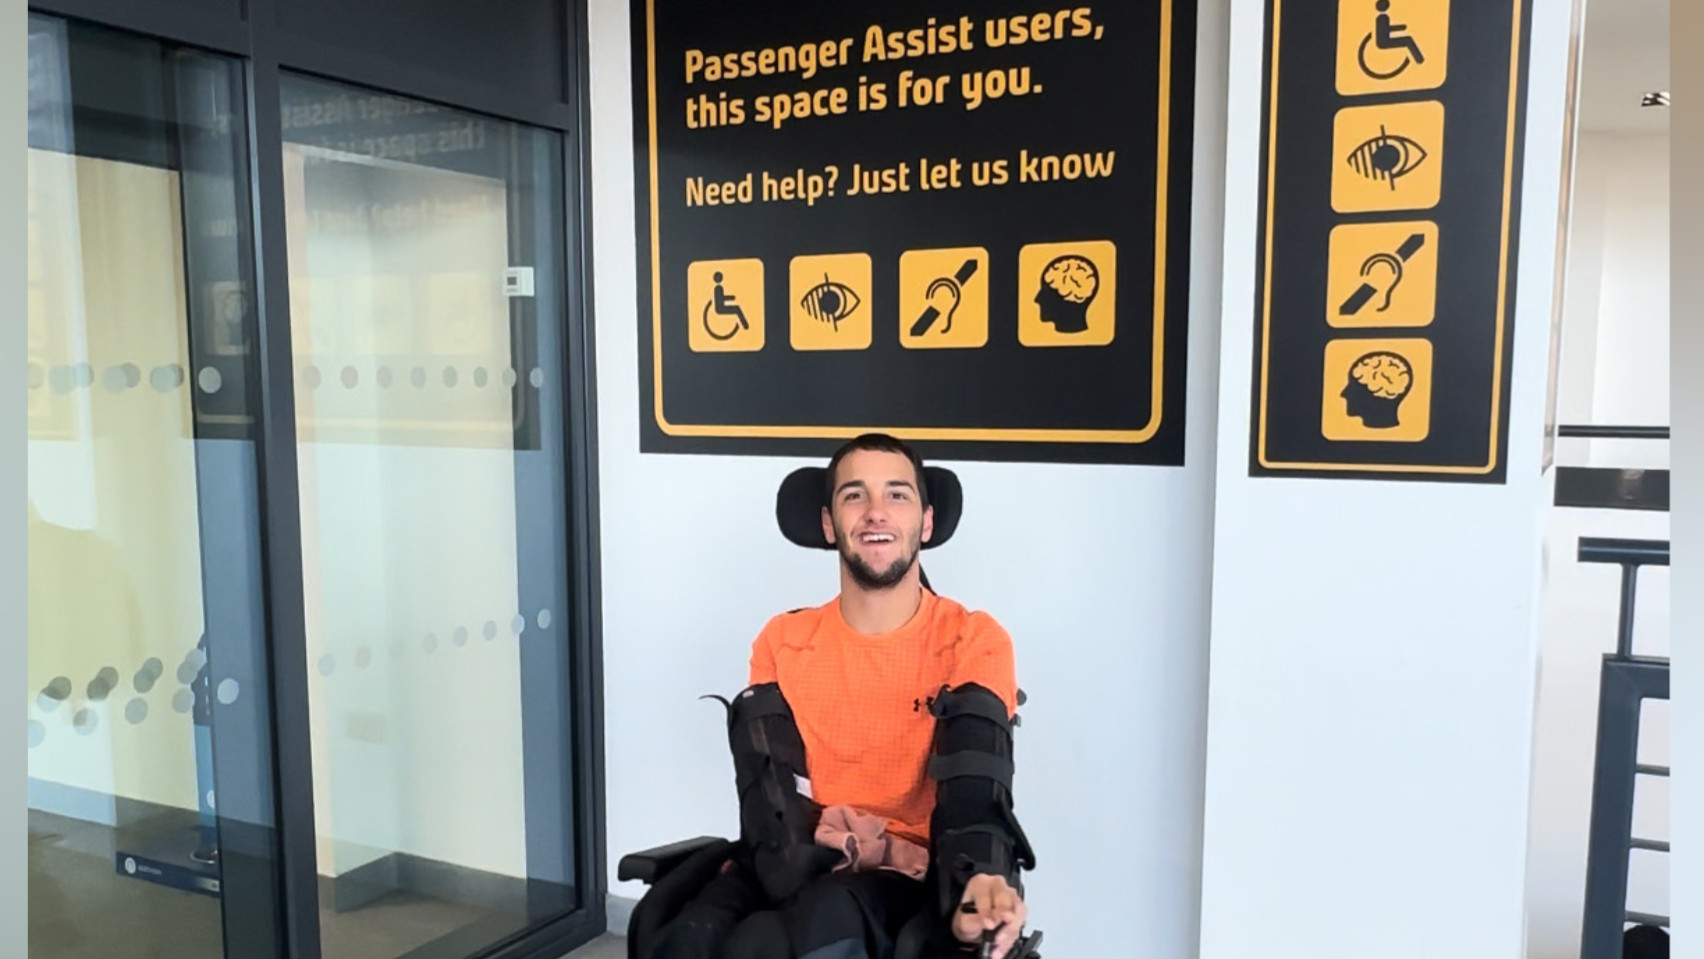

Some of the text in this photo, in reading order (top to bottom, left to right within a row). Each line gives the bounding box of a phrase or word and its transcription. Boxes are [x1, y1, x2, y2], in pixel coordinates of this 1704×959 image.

[684, 7, 1104, 84] Passenger Assist users,
[685, 65, 1043, 130] this space is for you.
[685, 149, 1115, 206] Need help? Just let us know
